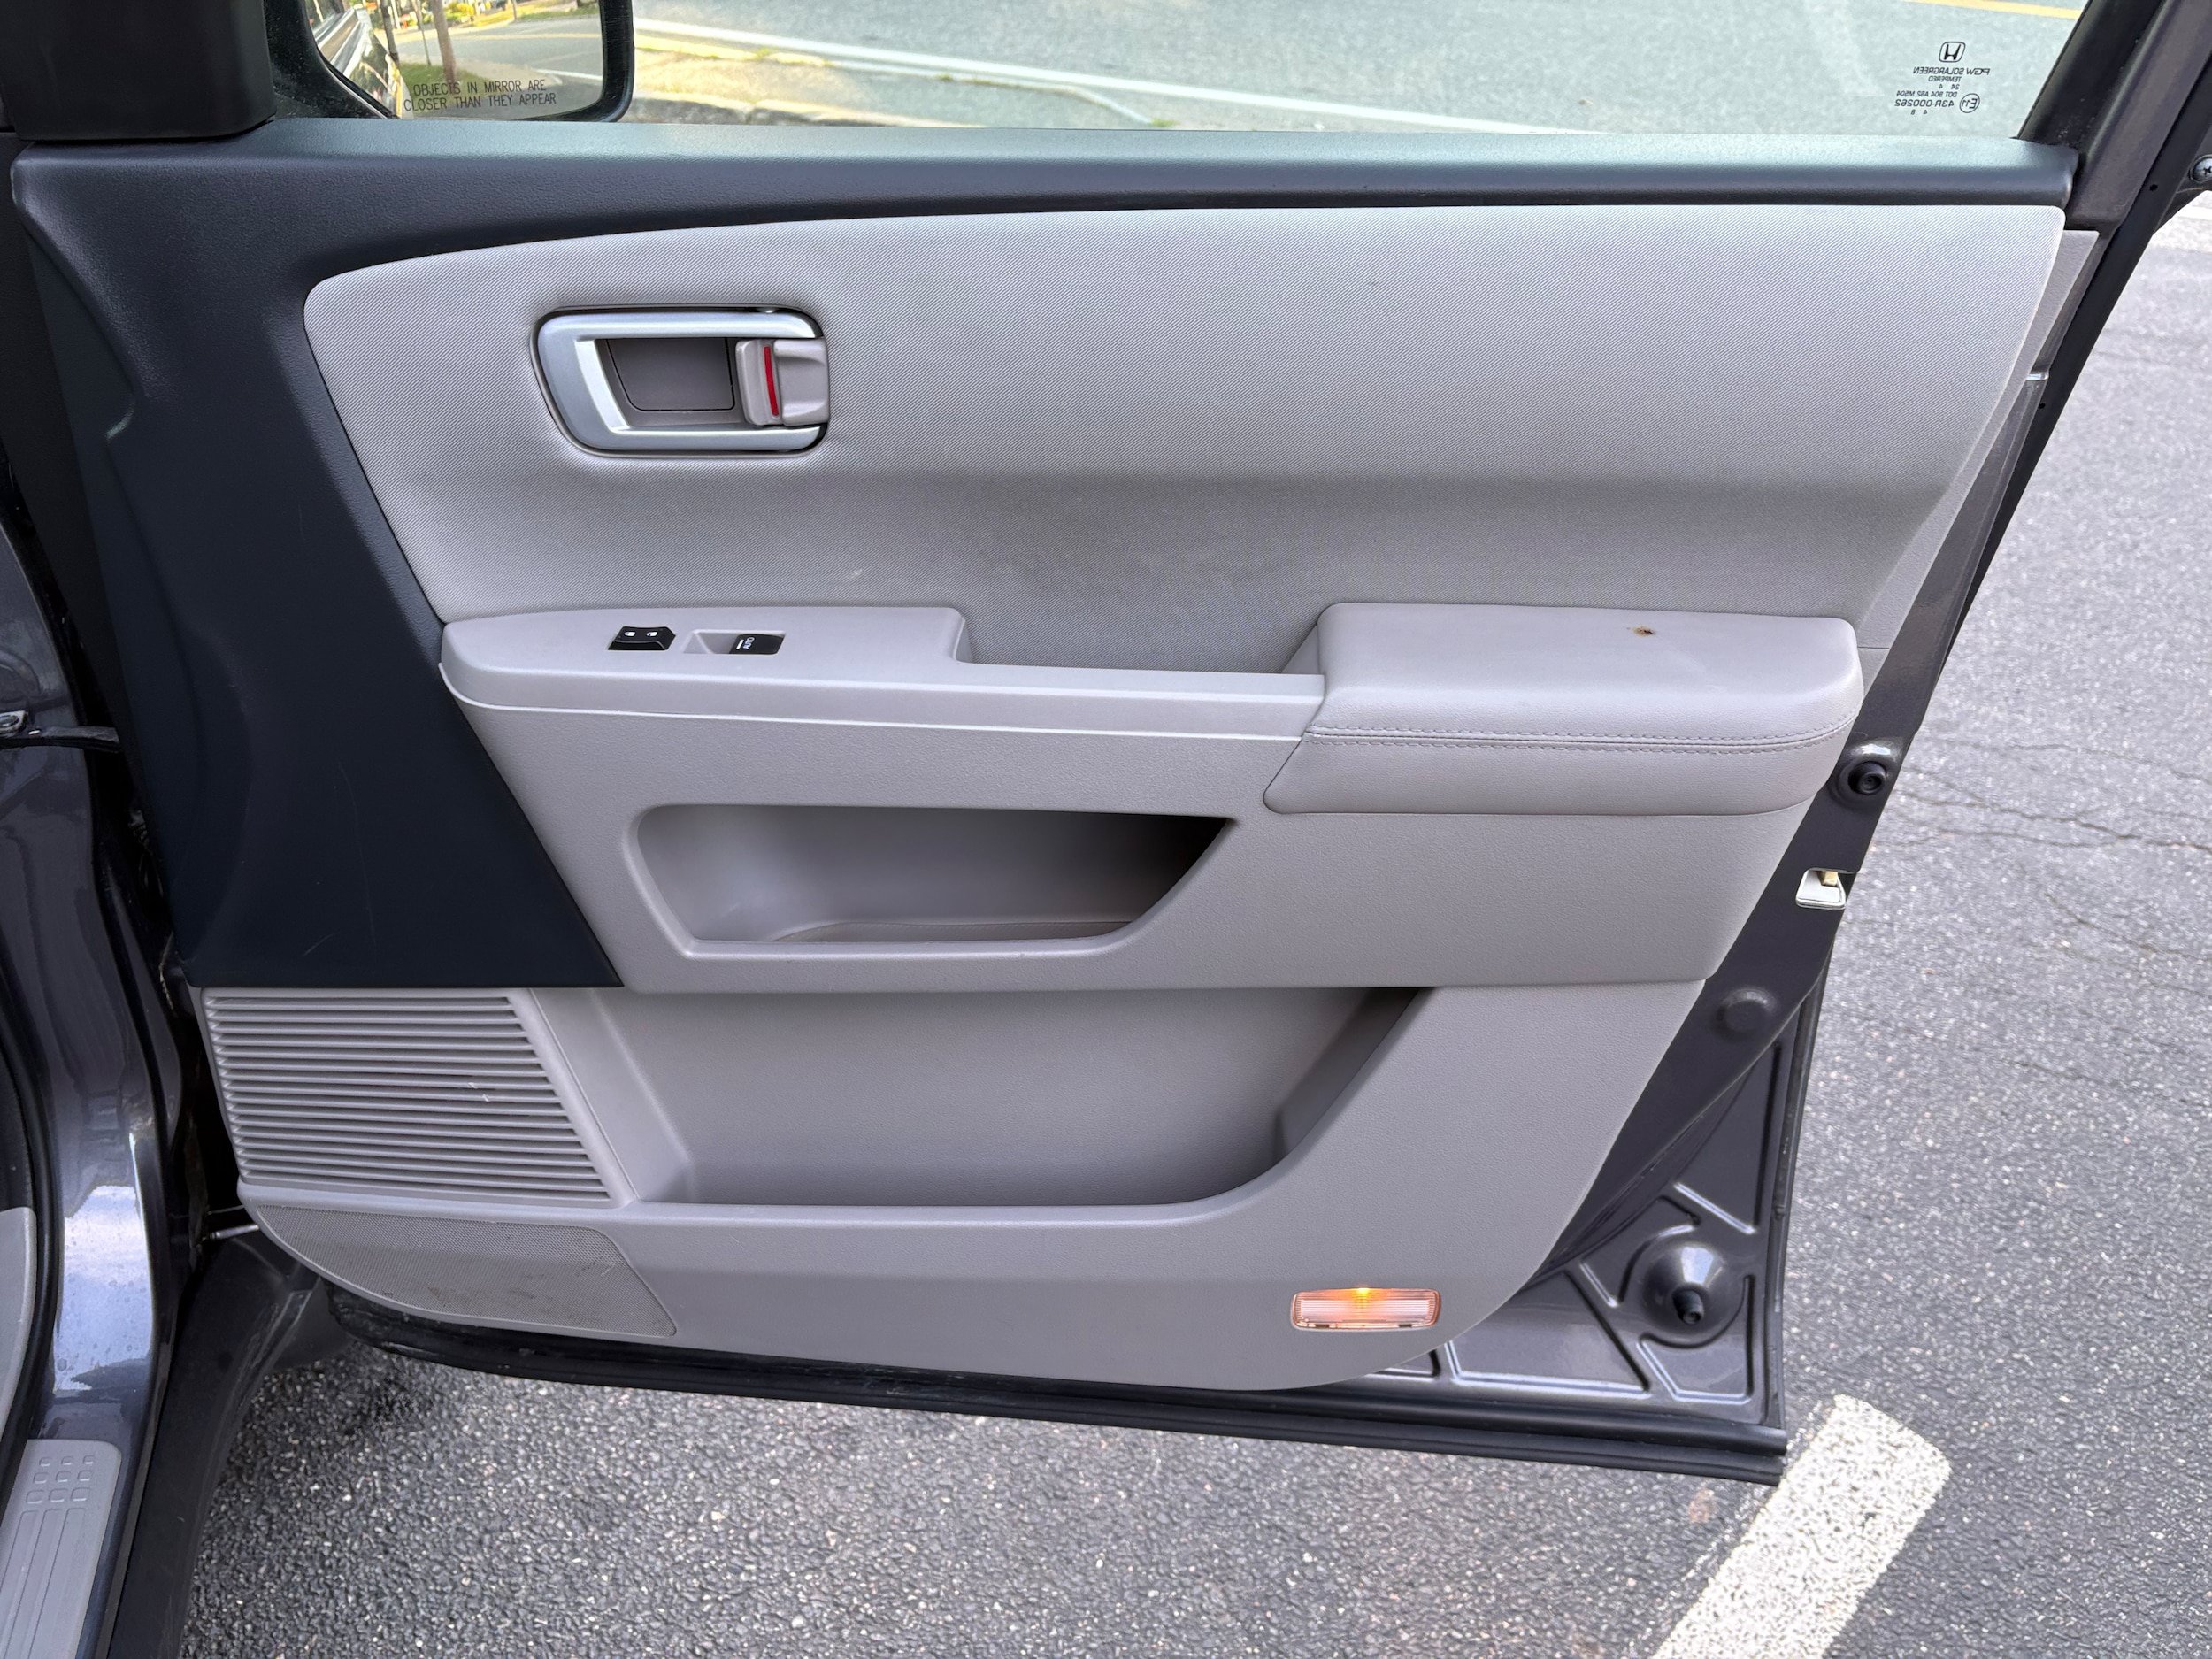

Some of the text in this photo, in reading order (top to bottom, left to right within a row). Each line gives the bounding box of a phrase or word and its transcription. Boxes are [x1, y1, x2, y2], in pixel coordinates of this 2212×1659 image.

[413, 79, 547, 96] OBJECTS IN MIRROR ARE
[403, 93, 557, 111] CLOSER THAN THEY APPEAR
